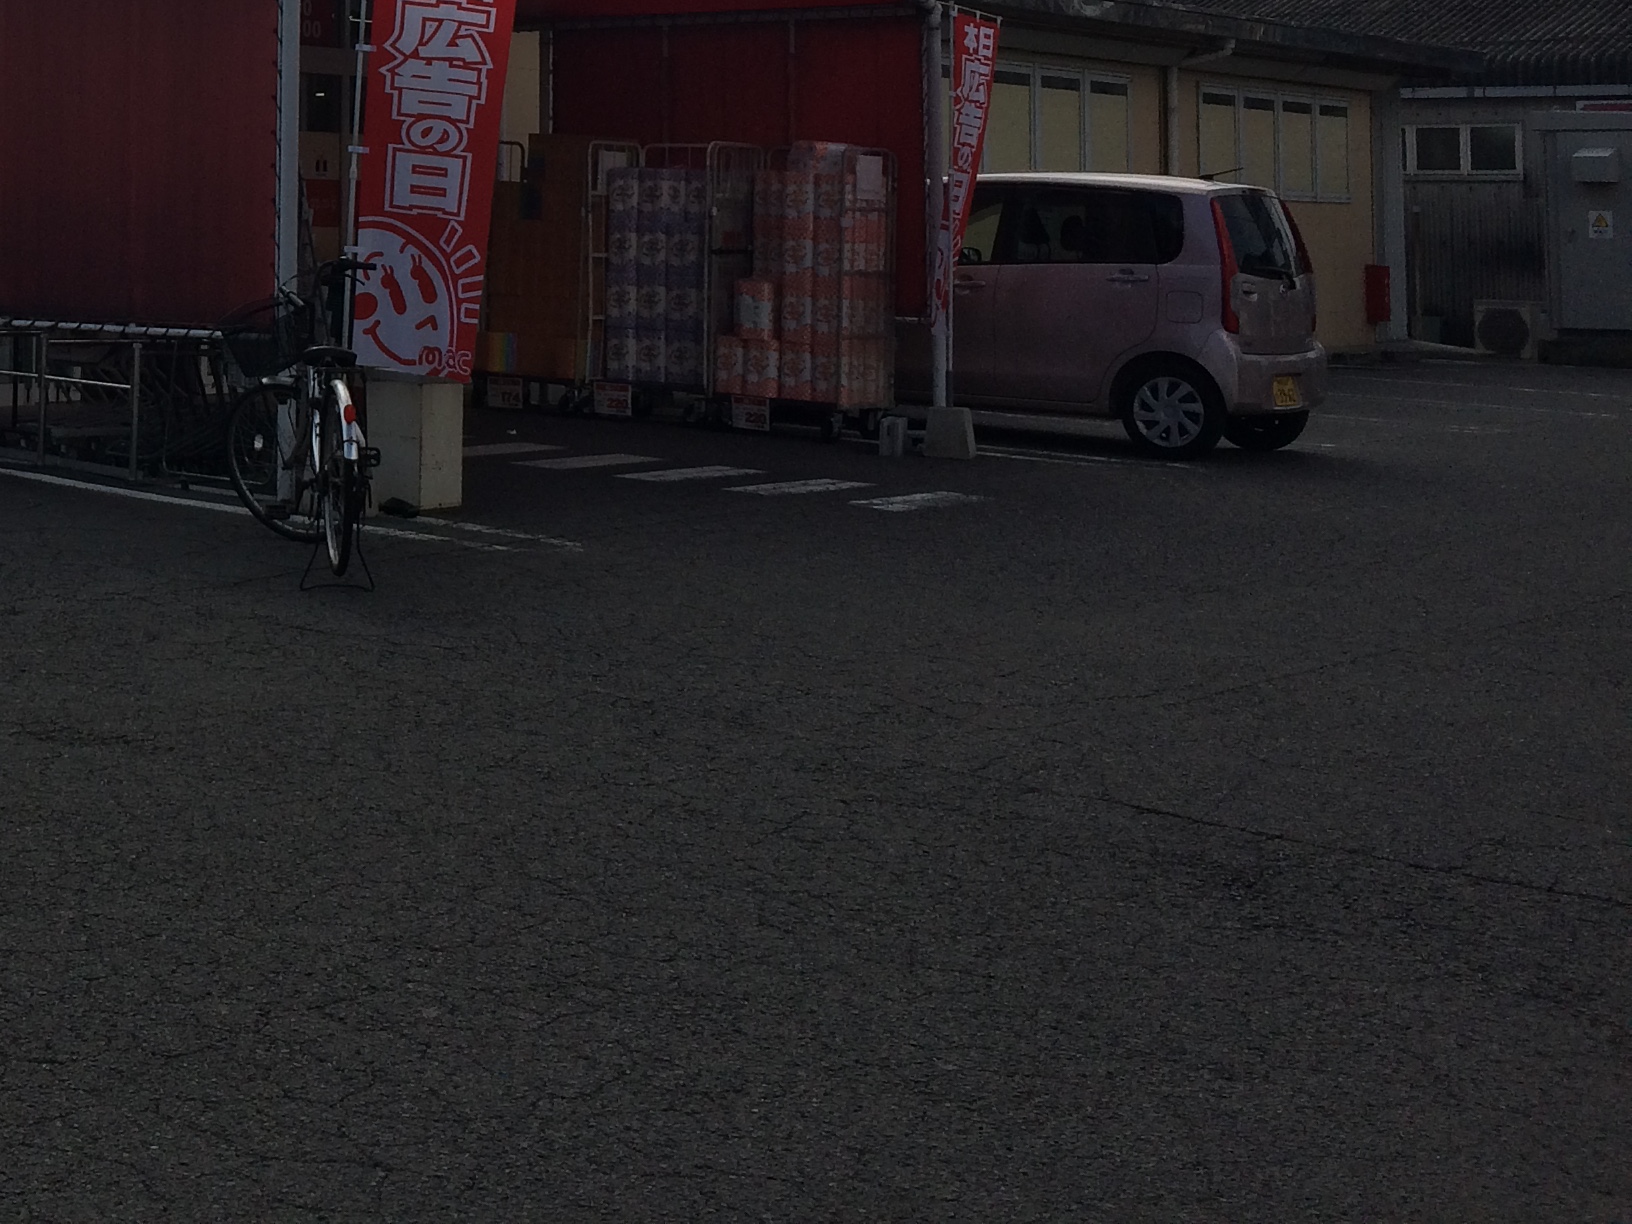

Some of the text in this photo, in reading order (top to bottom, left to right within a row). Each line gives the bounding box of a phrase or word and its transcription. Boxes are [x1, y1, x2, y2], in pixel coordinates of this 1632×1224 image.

[964, 23, 994, 58] 本日
[386, 0, 496, 219] 広告の日
